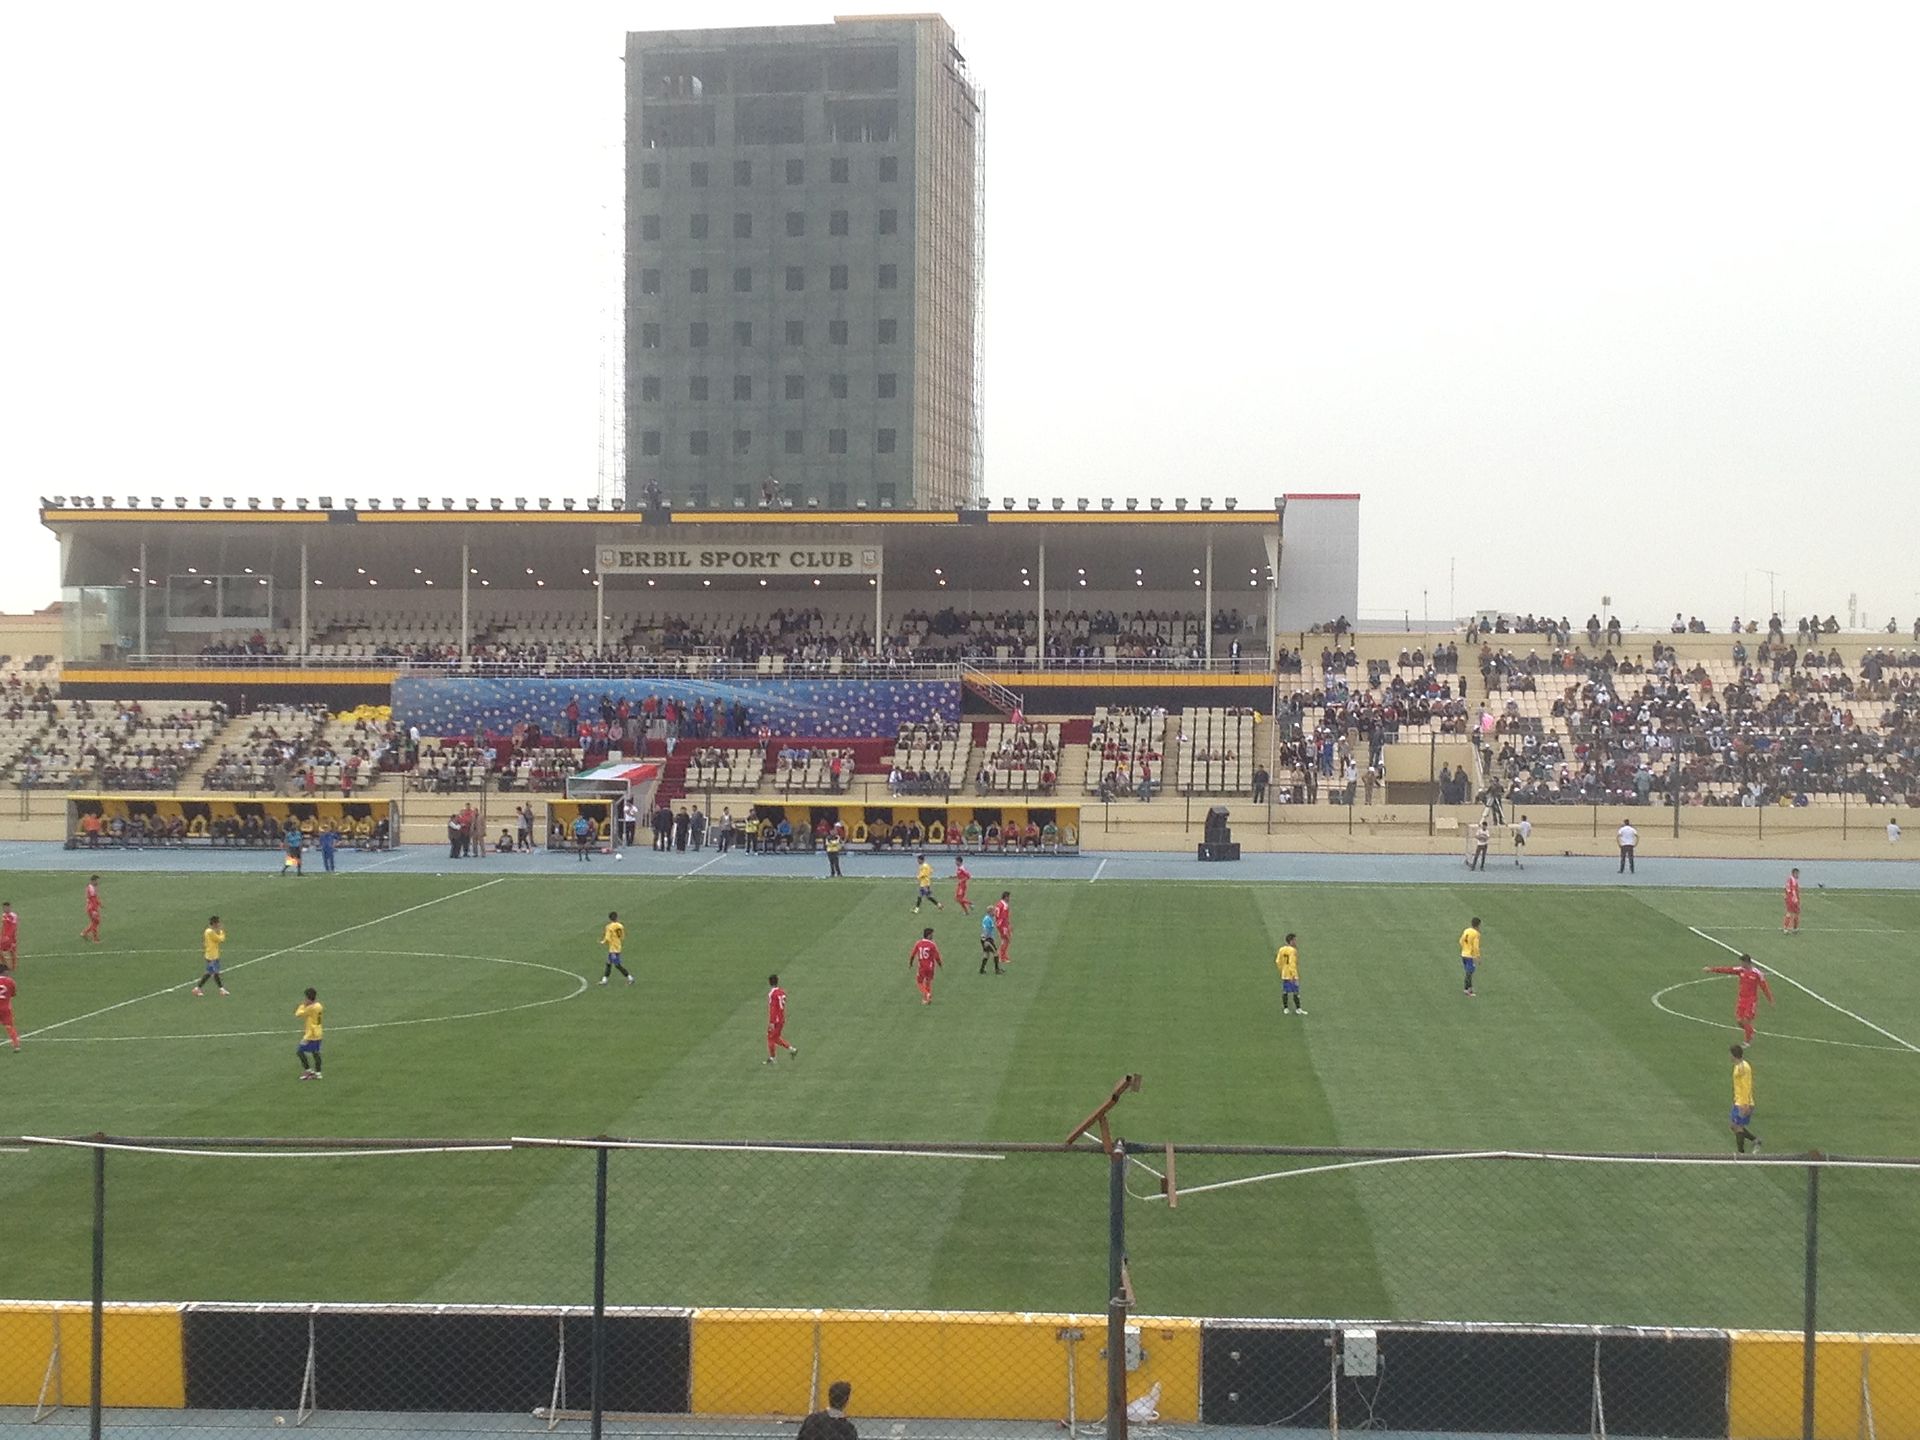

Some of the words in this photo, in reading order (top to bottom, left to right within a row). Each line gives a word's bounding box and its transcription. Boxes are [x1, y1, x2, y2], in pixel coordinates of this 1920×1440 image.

[618, 551, 692, 567] ERBIL
[699, 551, 781, 567] SPORT
[789, 551, 854, 568] CLUB
